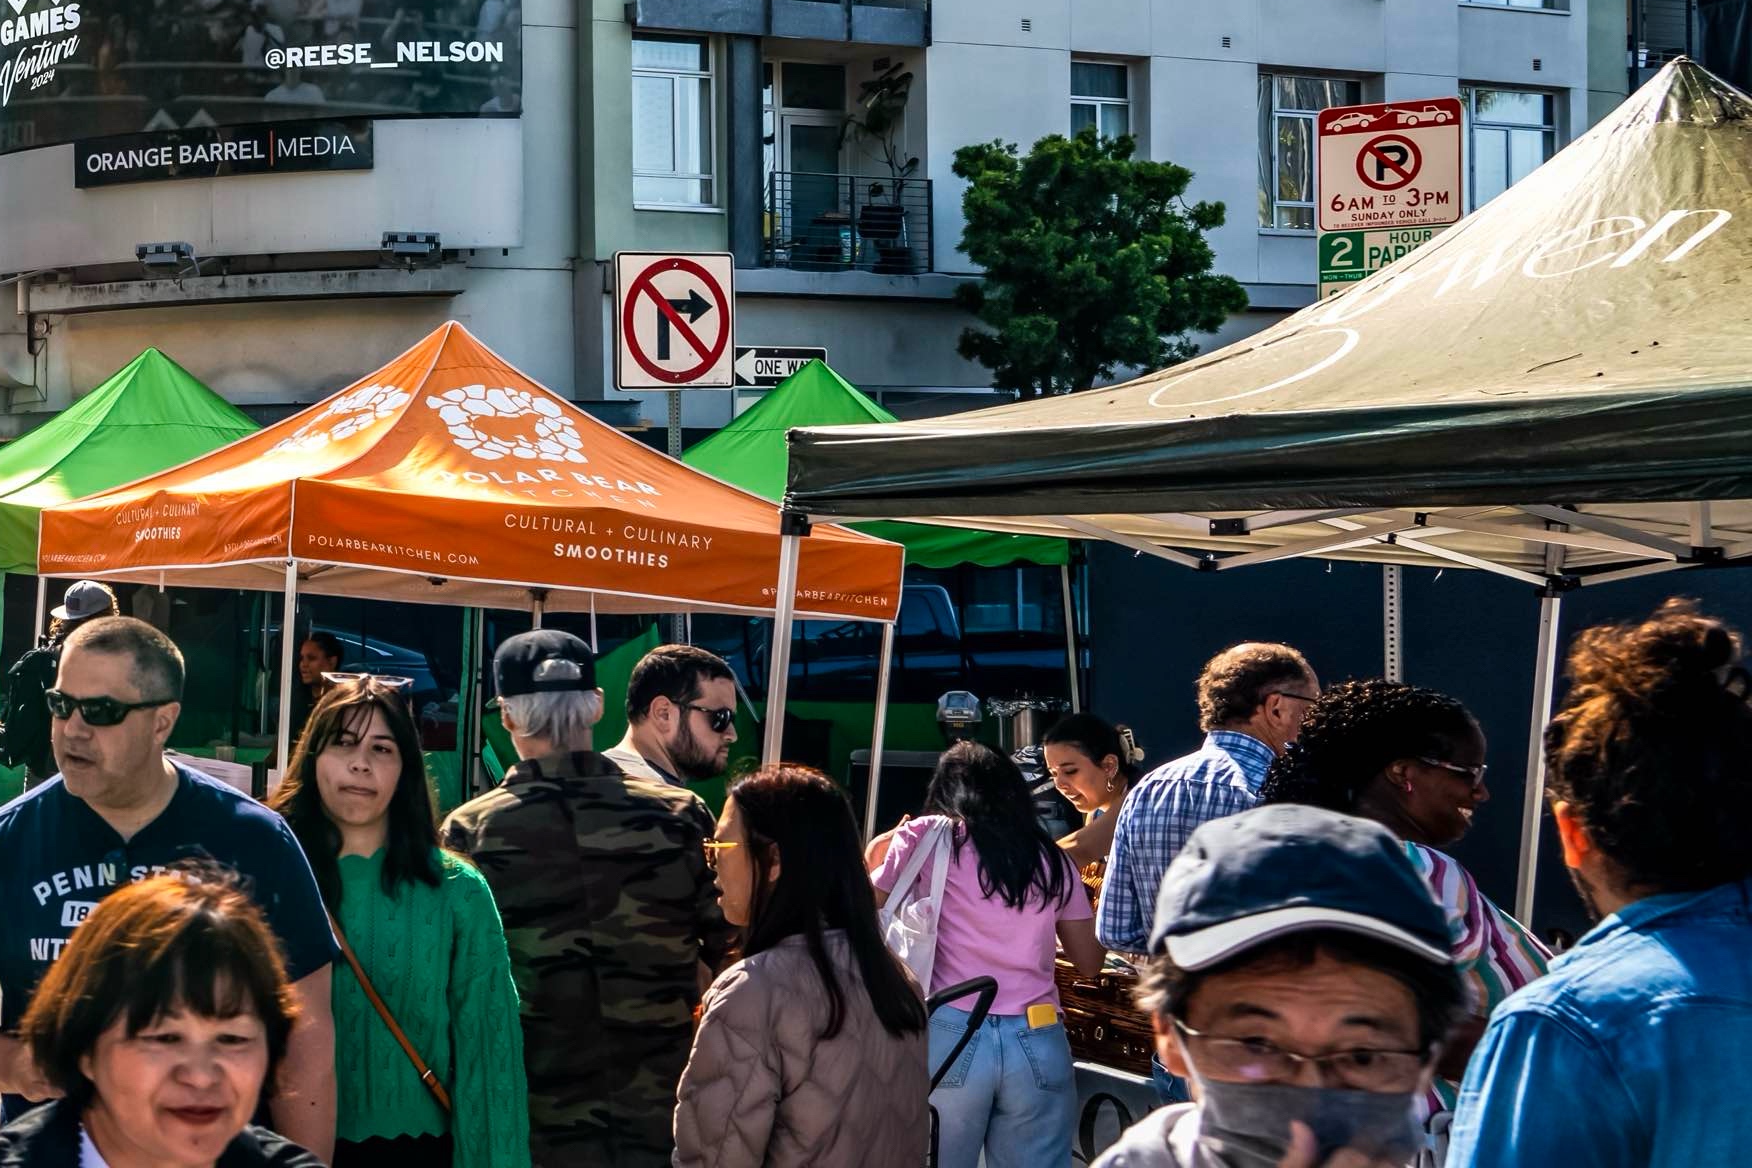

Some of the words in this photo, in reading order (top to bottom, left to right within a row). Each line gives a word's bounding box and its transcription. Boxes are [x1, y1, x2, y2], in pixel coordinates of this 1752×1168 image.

[0, 3, 81, 46] GAMES
[30, 69, 56, 91] 2024
[86, 146, 172, 174] ORANGE
[179, 140, 265, 164] BARREL
[277, 135, 356, 158] MEDIA
[1330, 193, 1374, 212] 6AM
[1383, 194, 1396, 204] TO
[1405, 187, 1449, 207] 3PM
[1351, 211, 1395, 222] SUNDAY
[1398, 208, 1427, 219] ONLY
[1330, 236, 1353, 267] 2
[1389, 231, 1433, 244] HOUR
[754, 359, 782, 375] ONE
[437, 468, 564, 485] POLAR
[569, 471, 663, 497] BEAR
[115, 508, 153, 525] CULTURAL
[162, 503, 202, 518] CULINARY
[134, 526, 181, 543] SMOOTHIES
[504, 513, 597, 536] CULTURAL
[623, 526, 713, 551] CULINARY
[308, 534, 480, 565] POLARBEARKITCHEN.COM
[553, 543, 669, 568] SMOOTHIES
[761, 587, 888, 607] @PARBEARKITCHEN
[32, 862, 117, 907] PENN
